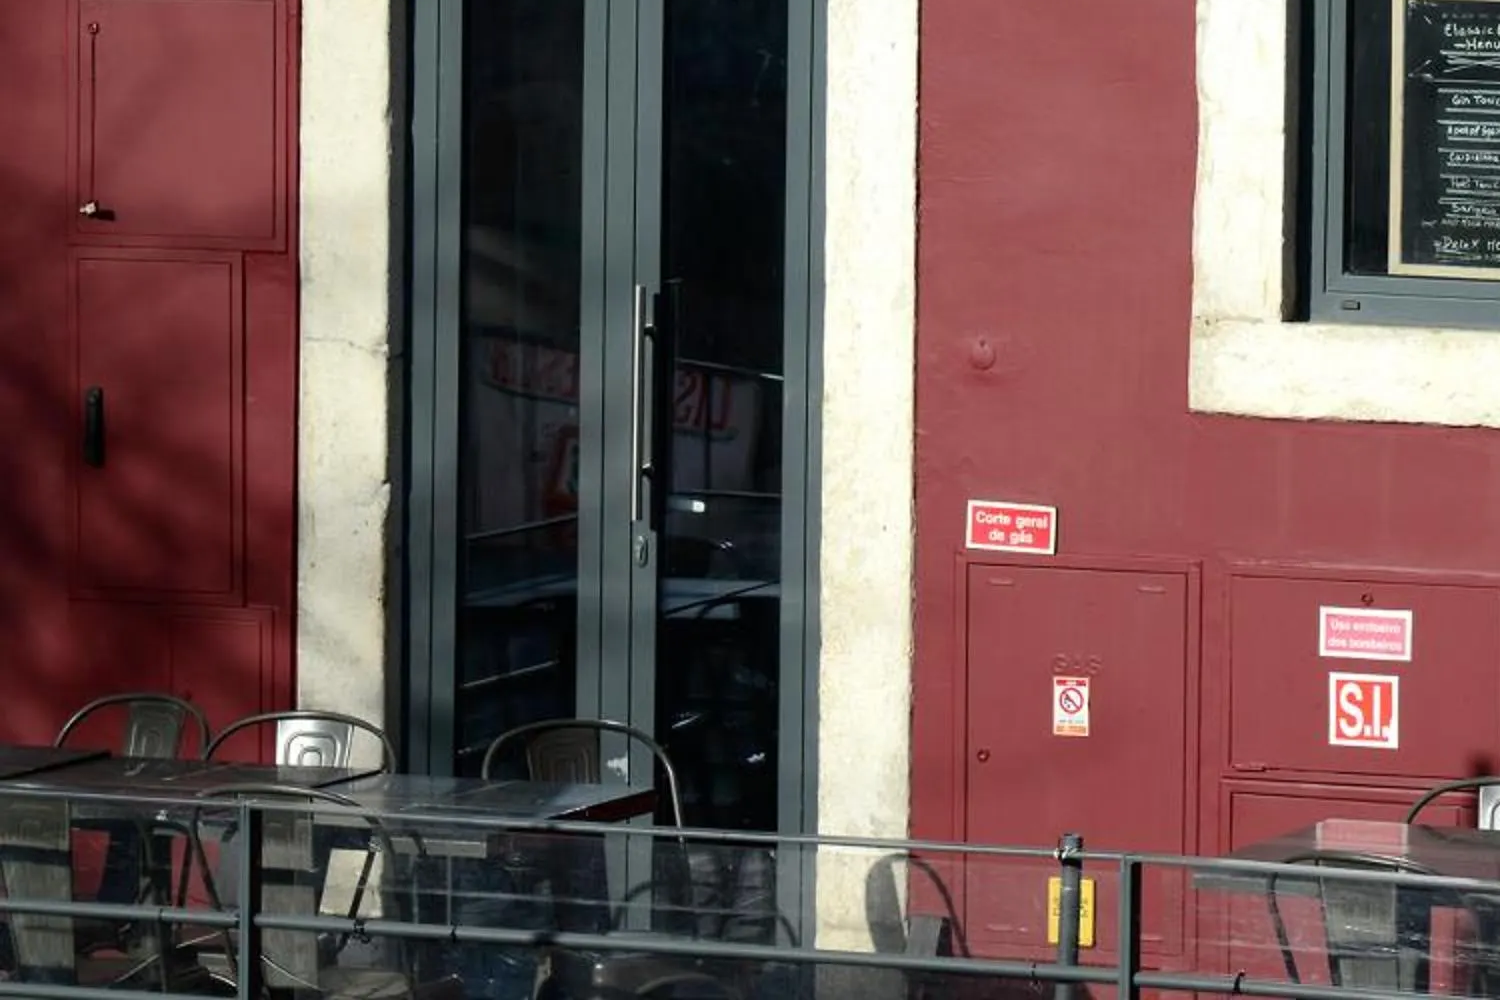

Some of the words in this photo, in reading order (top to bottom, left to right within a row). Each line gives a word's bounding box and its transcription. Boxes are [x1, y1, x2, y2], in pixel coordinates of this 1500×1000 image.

[976, 510, 1011, 525] Corte
[1015, 514, 1048, 529] geral
[988, 528, 1005, 541] de
